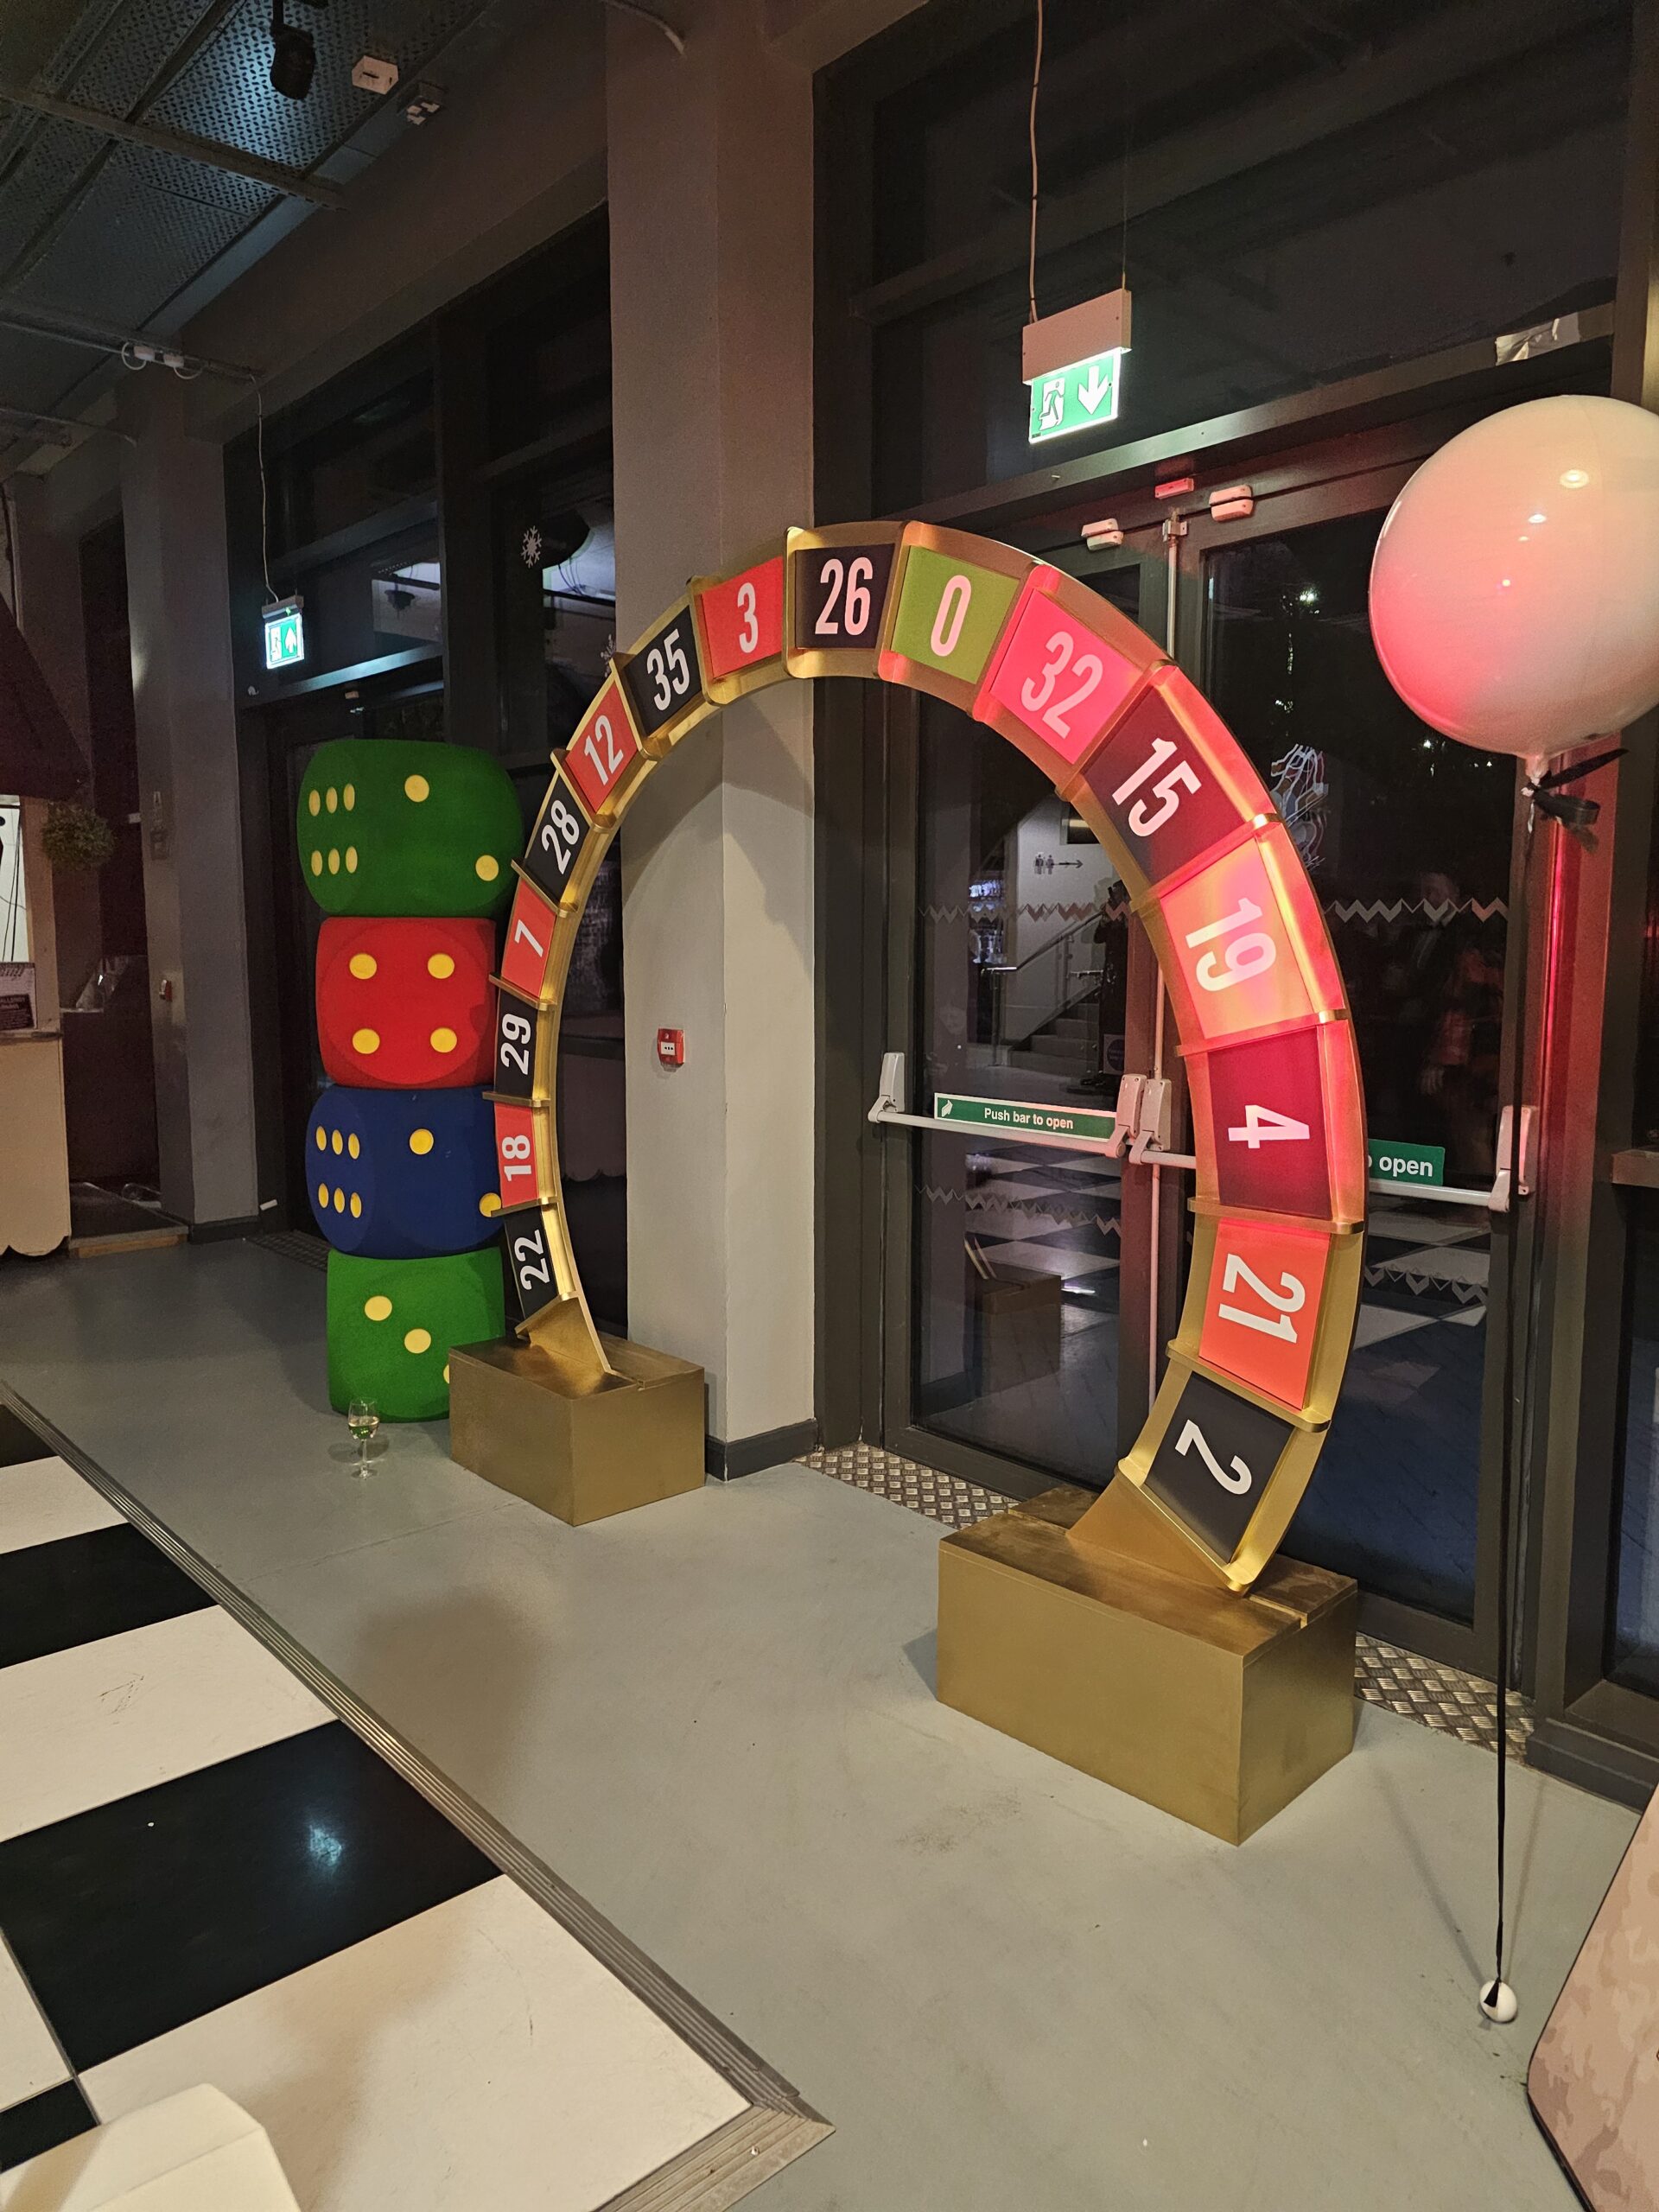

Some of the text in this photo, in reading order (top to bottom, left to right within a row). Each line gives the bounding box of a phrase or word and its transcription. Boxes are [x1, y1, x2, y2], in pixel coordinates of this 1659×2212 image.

[736, 581, 759, 654] 3
[814, 555, 874, 638] 26
[929, 572, 973, 658] 0
[645, 627, 690, 712] 35
[1020, 629, 1105, 740] 32
[582, 714, 624, 785] 12
[1111, 736, 1203, 838] 15
[540, 798, 581, 875] 28
[513, 918, 544, 957] 7
[1184, 896, 1277, 993] 19
[500, 1012, 532, 1076] 29
[984, 1107, 1073, 1130] Push bar to open
[1227, 1103, 1311, 1150] 4
[501, 1133, 533, 1182] 18
[1379, 1156, 1433, 1178] open
[513, 1227, 550, 1292] 22
[1218, 1254, 1306, 1344] 21
[1173, 1418, 1253, 1496] 2
